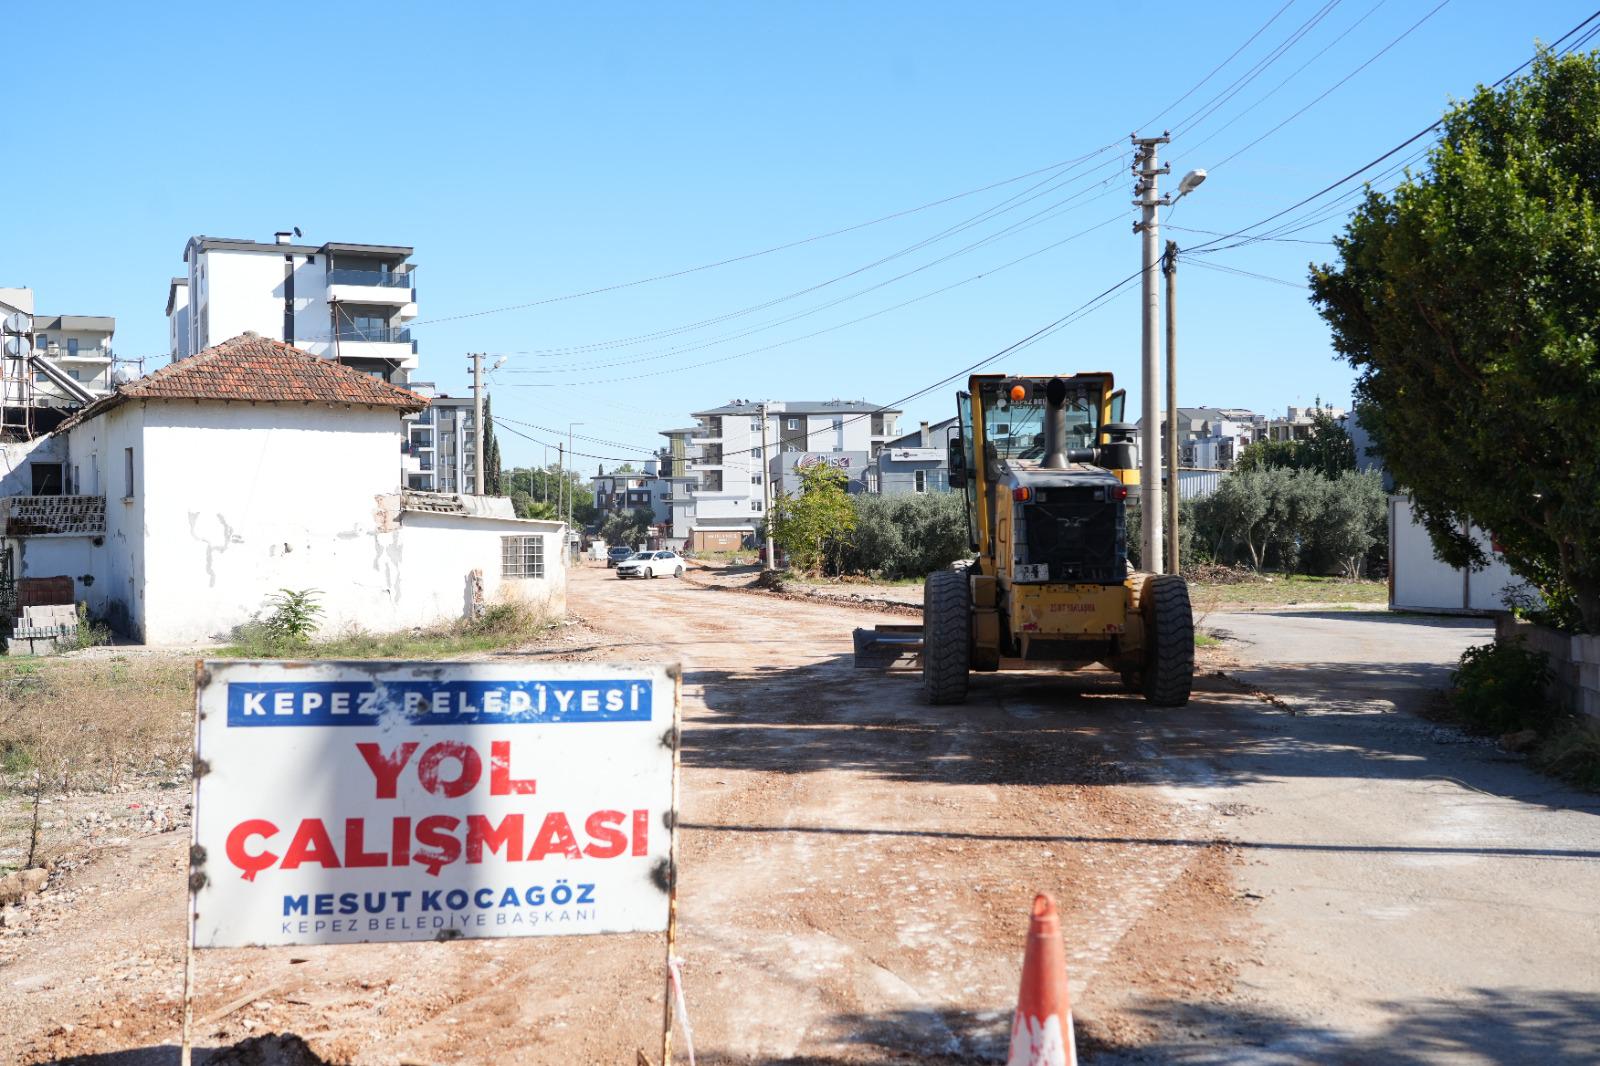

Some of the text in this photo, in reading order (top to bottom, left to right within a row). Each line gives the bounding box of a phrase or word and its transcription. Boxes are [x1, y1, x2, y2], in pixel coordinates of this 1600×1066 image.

[243, 685, 640, 716] KEPEZ BELEDİYESİ
[356, 741, 536, 799] YOL
[226, 809, 649, 882] ÇALIŞMASI
[283, 879, 596, 916] MESUT KOCAGÖZ
[282, 917, 359, 934] KEPEZ
[369, 912, 487, 931] BELEDİYE
